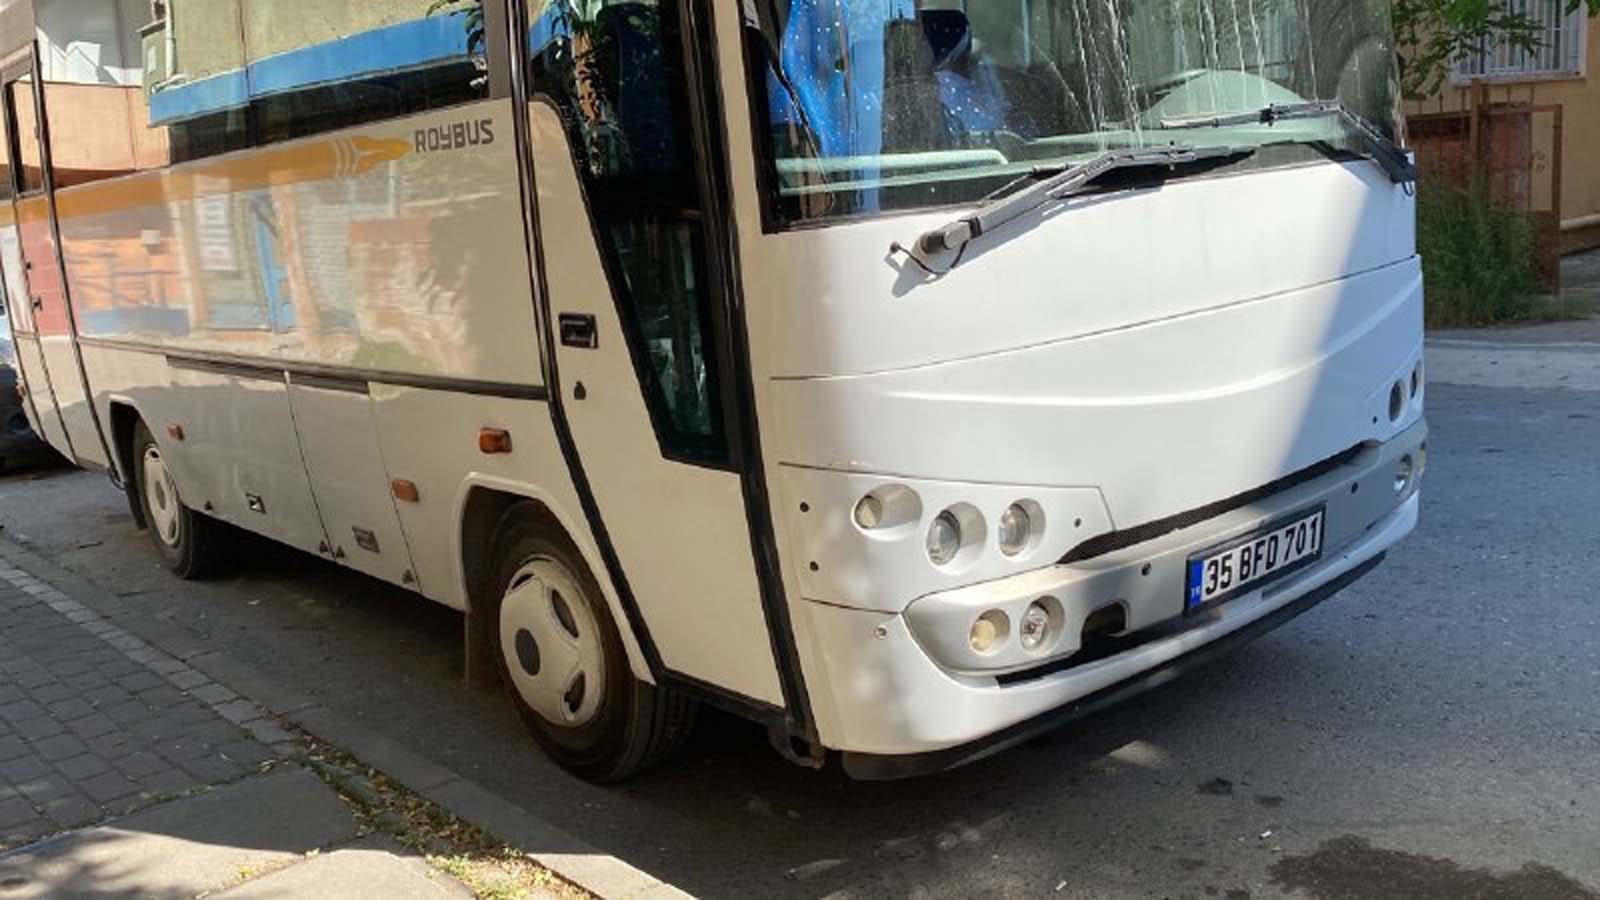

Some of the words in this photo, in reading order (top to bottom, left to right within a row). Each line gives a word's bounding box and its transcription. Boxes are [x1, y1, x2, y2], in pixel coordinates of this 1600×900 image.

[415, 119, 495, 153] ROYBUS
[1206, 553, 1233, 595] 35
[1240, 534, 1279, 581] BFD
[1284, 516, 1318, 561] 701
